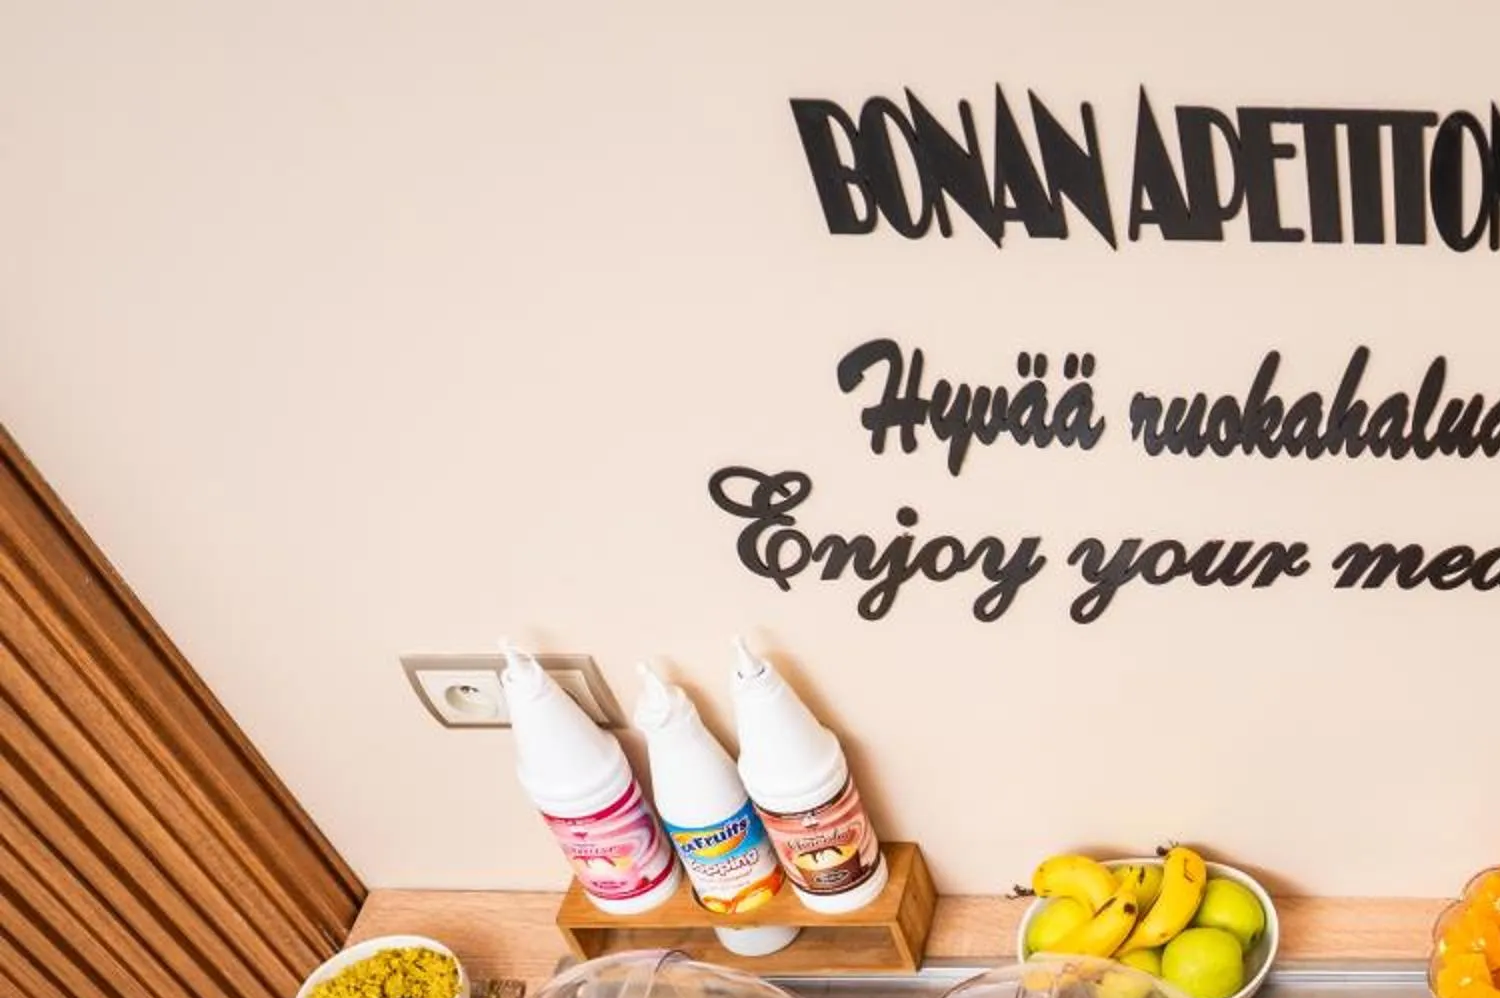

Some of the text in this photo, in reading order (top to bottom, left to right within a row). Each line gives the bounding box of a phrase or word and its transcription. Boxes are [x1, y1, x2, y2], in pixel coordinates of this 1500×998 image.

[788, 82, 1118, 251] BONAN
[836, 337, 1106, 477] Hyvää
[707, 465, 1048, 624] Enjoy
[1066, 537, 1311, 626] your
